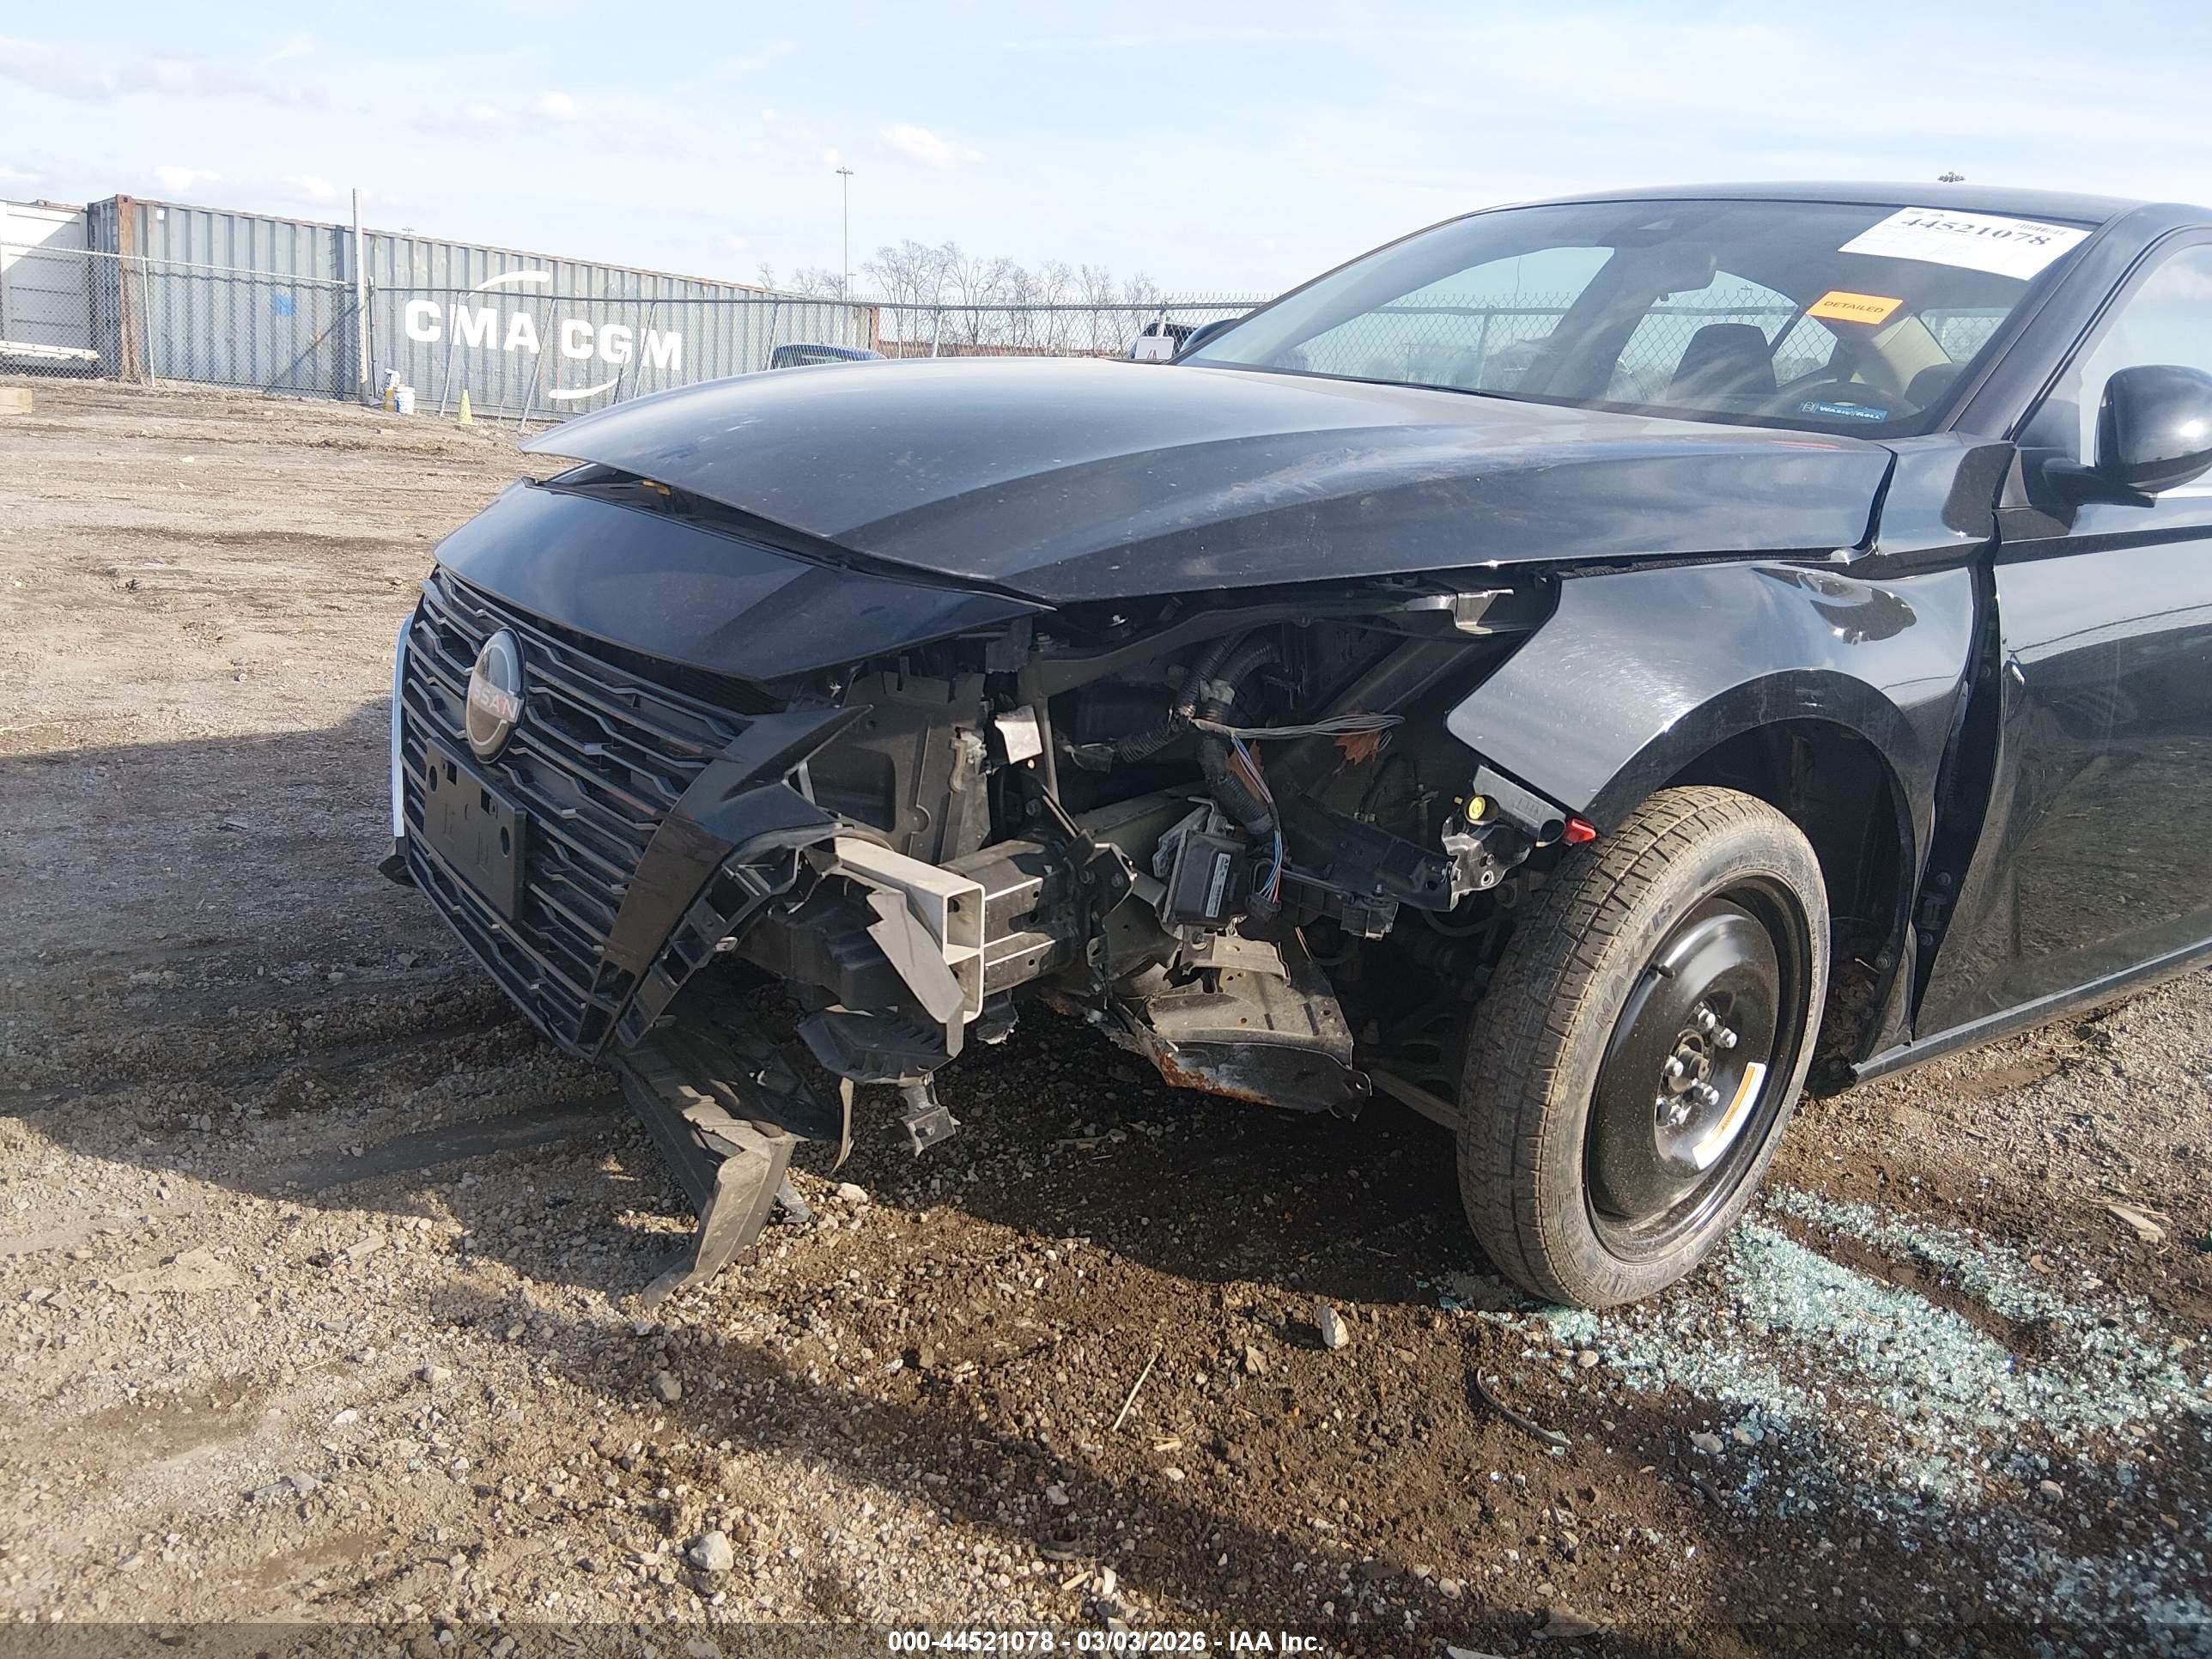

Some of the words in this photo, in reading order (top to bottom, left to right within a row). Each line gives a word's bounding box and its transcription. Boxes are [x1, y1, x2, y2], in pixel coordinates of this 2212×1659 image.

[1901, 218, 2051, 246] 44521078
[1824, 301, 1884, 313] DETAILED
[404, 299, 541, 355] CMA
[561, 318, 683, 371] CGM
[1595, 898, 1674, 1030] MAXXIS
